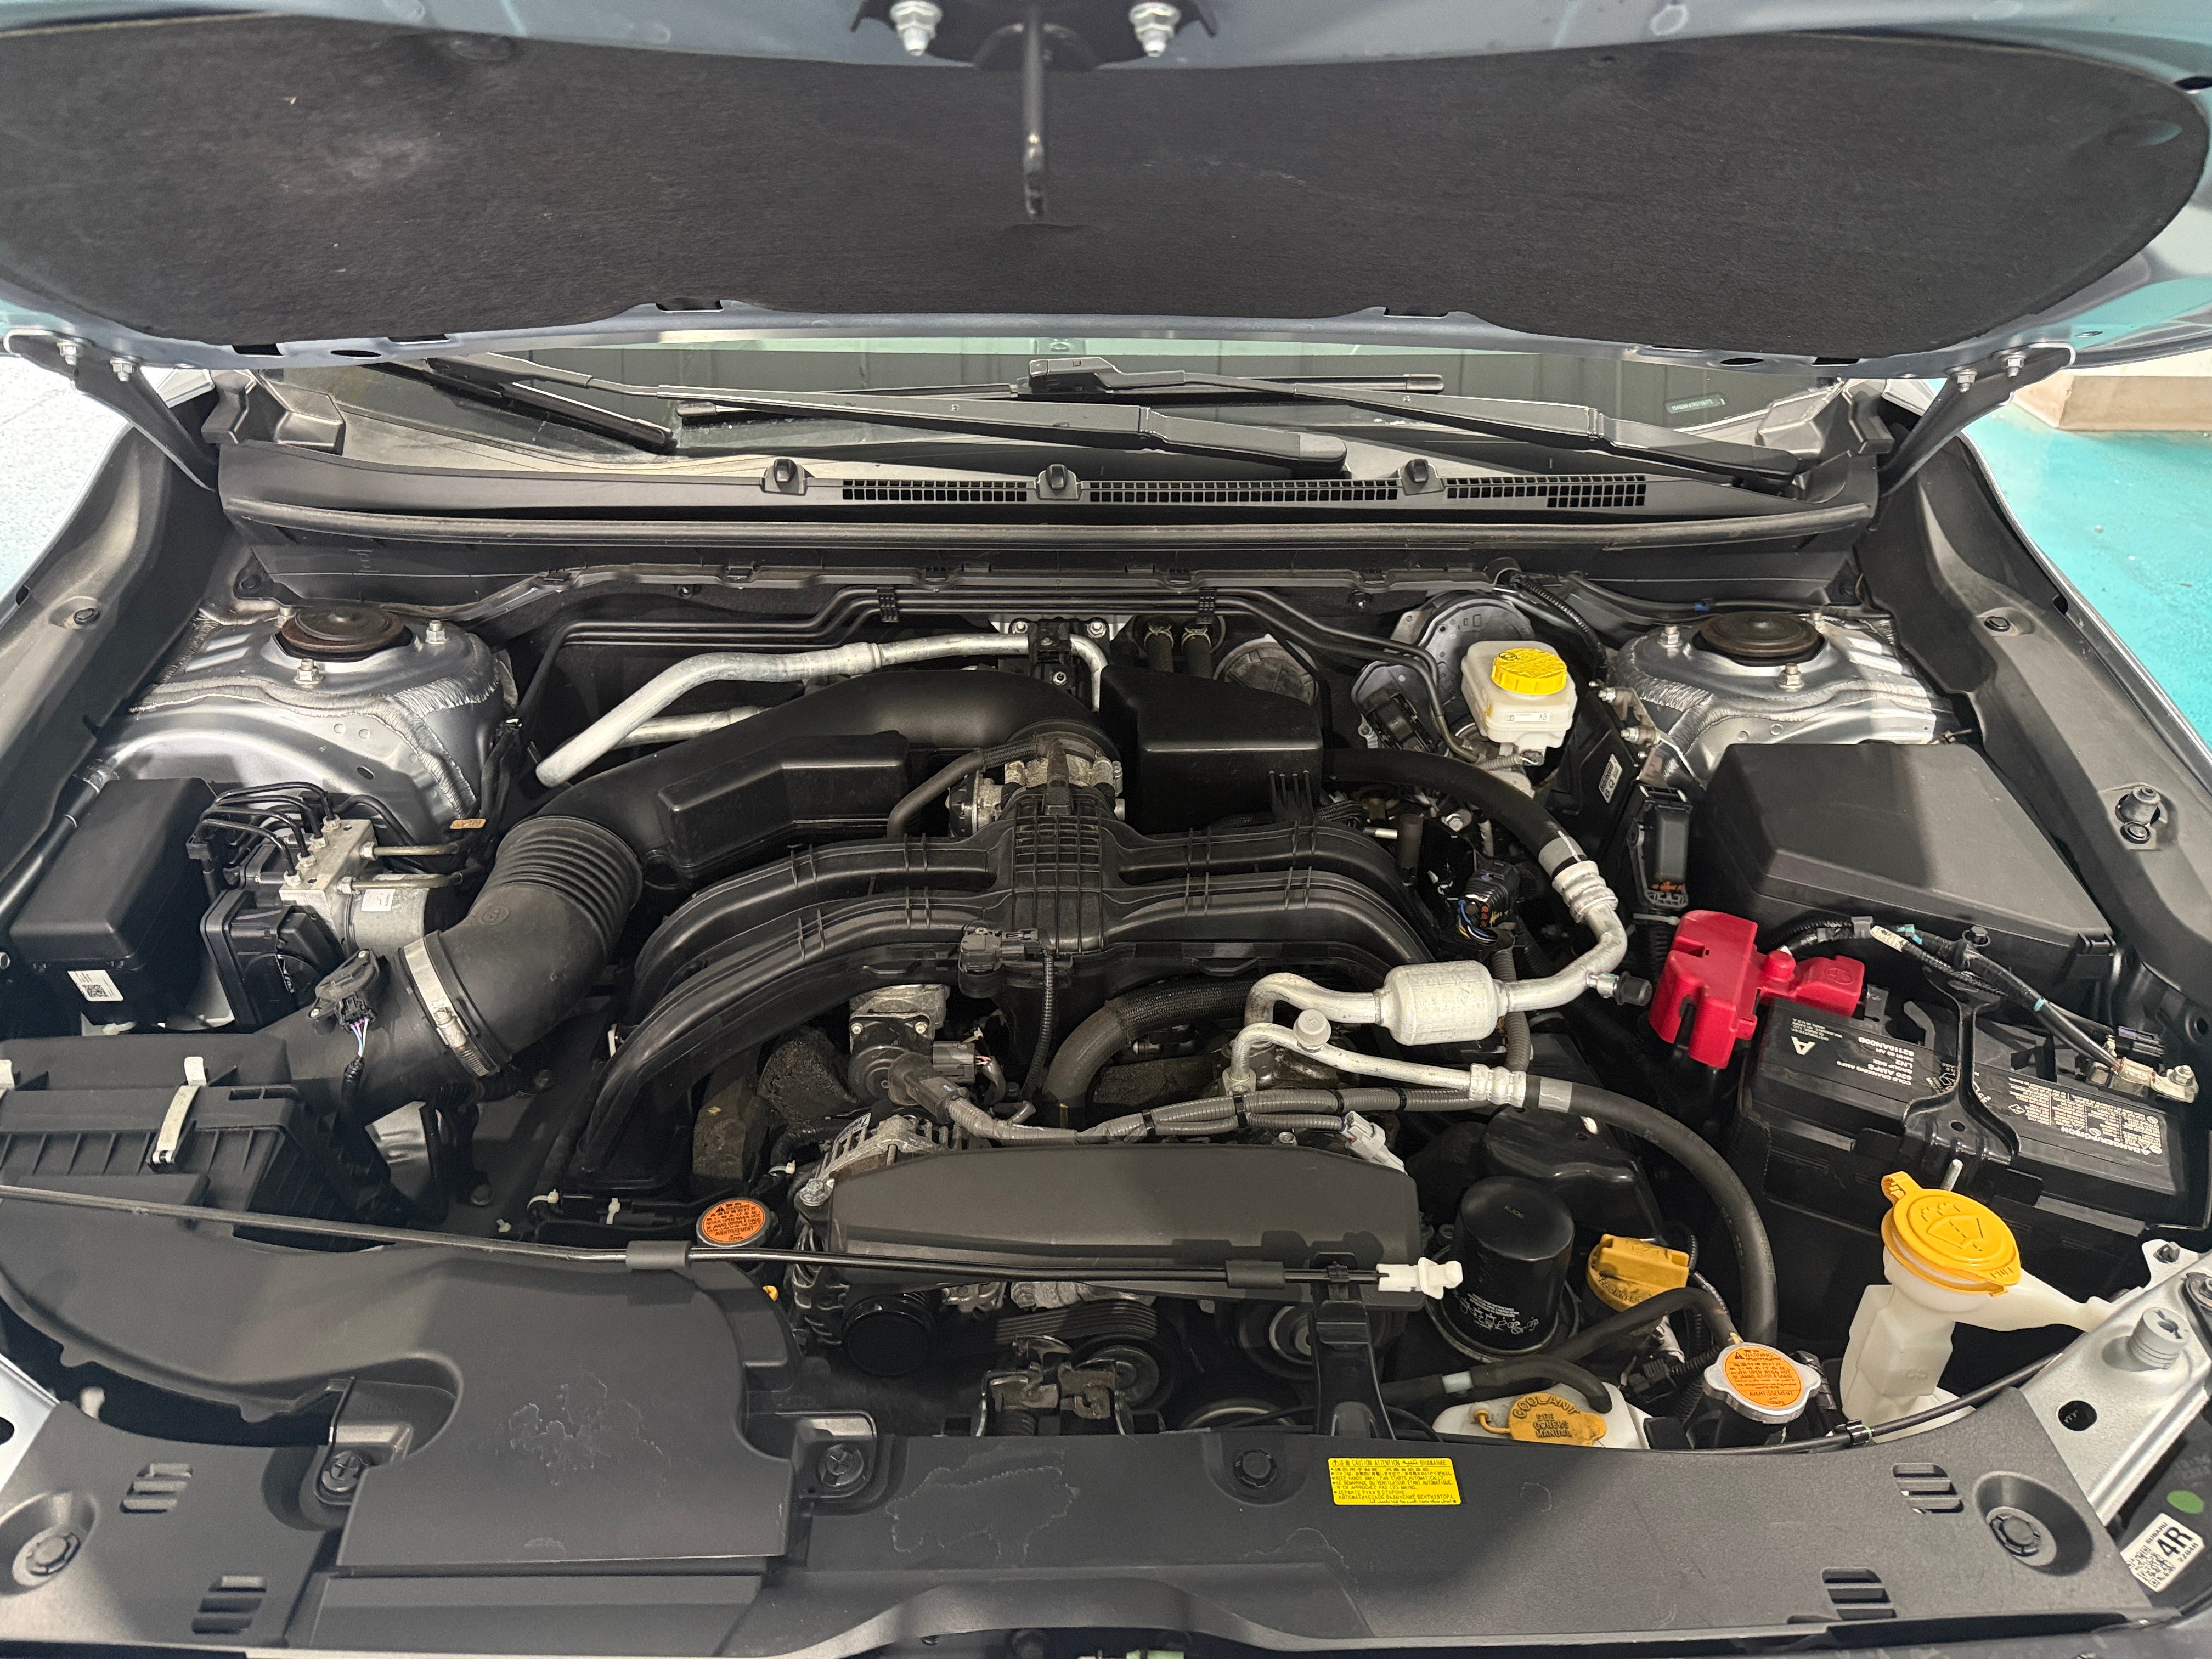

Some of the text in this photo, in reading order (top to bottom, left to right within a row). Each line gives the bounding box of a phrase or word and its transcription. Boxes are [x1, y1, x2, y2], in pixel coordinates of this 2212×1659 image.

[1791, 1036, 1815, 1056] A
[1888, 1064, 1913, 1074] GROUP
[1895, 1059, 1913, 1069] LN2
[1836, 1060, 1911, 1086] COLD CRANKING AMPS
[1867, 1064, 1912, 1081] 620 AMPS
[1512, 1395, 1581, 1420] COOLANT
[1536, 1413, 1555, 1421] SEE
[1533, 1420, 1569, 1430] OWNERS
[1536, 1427, 1572, 1438] MANUAL
[2157, 1527, 2193, 1557] 4R
